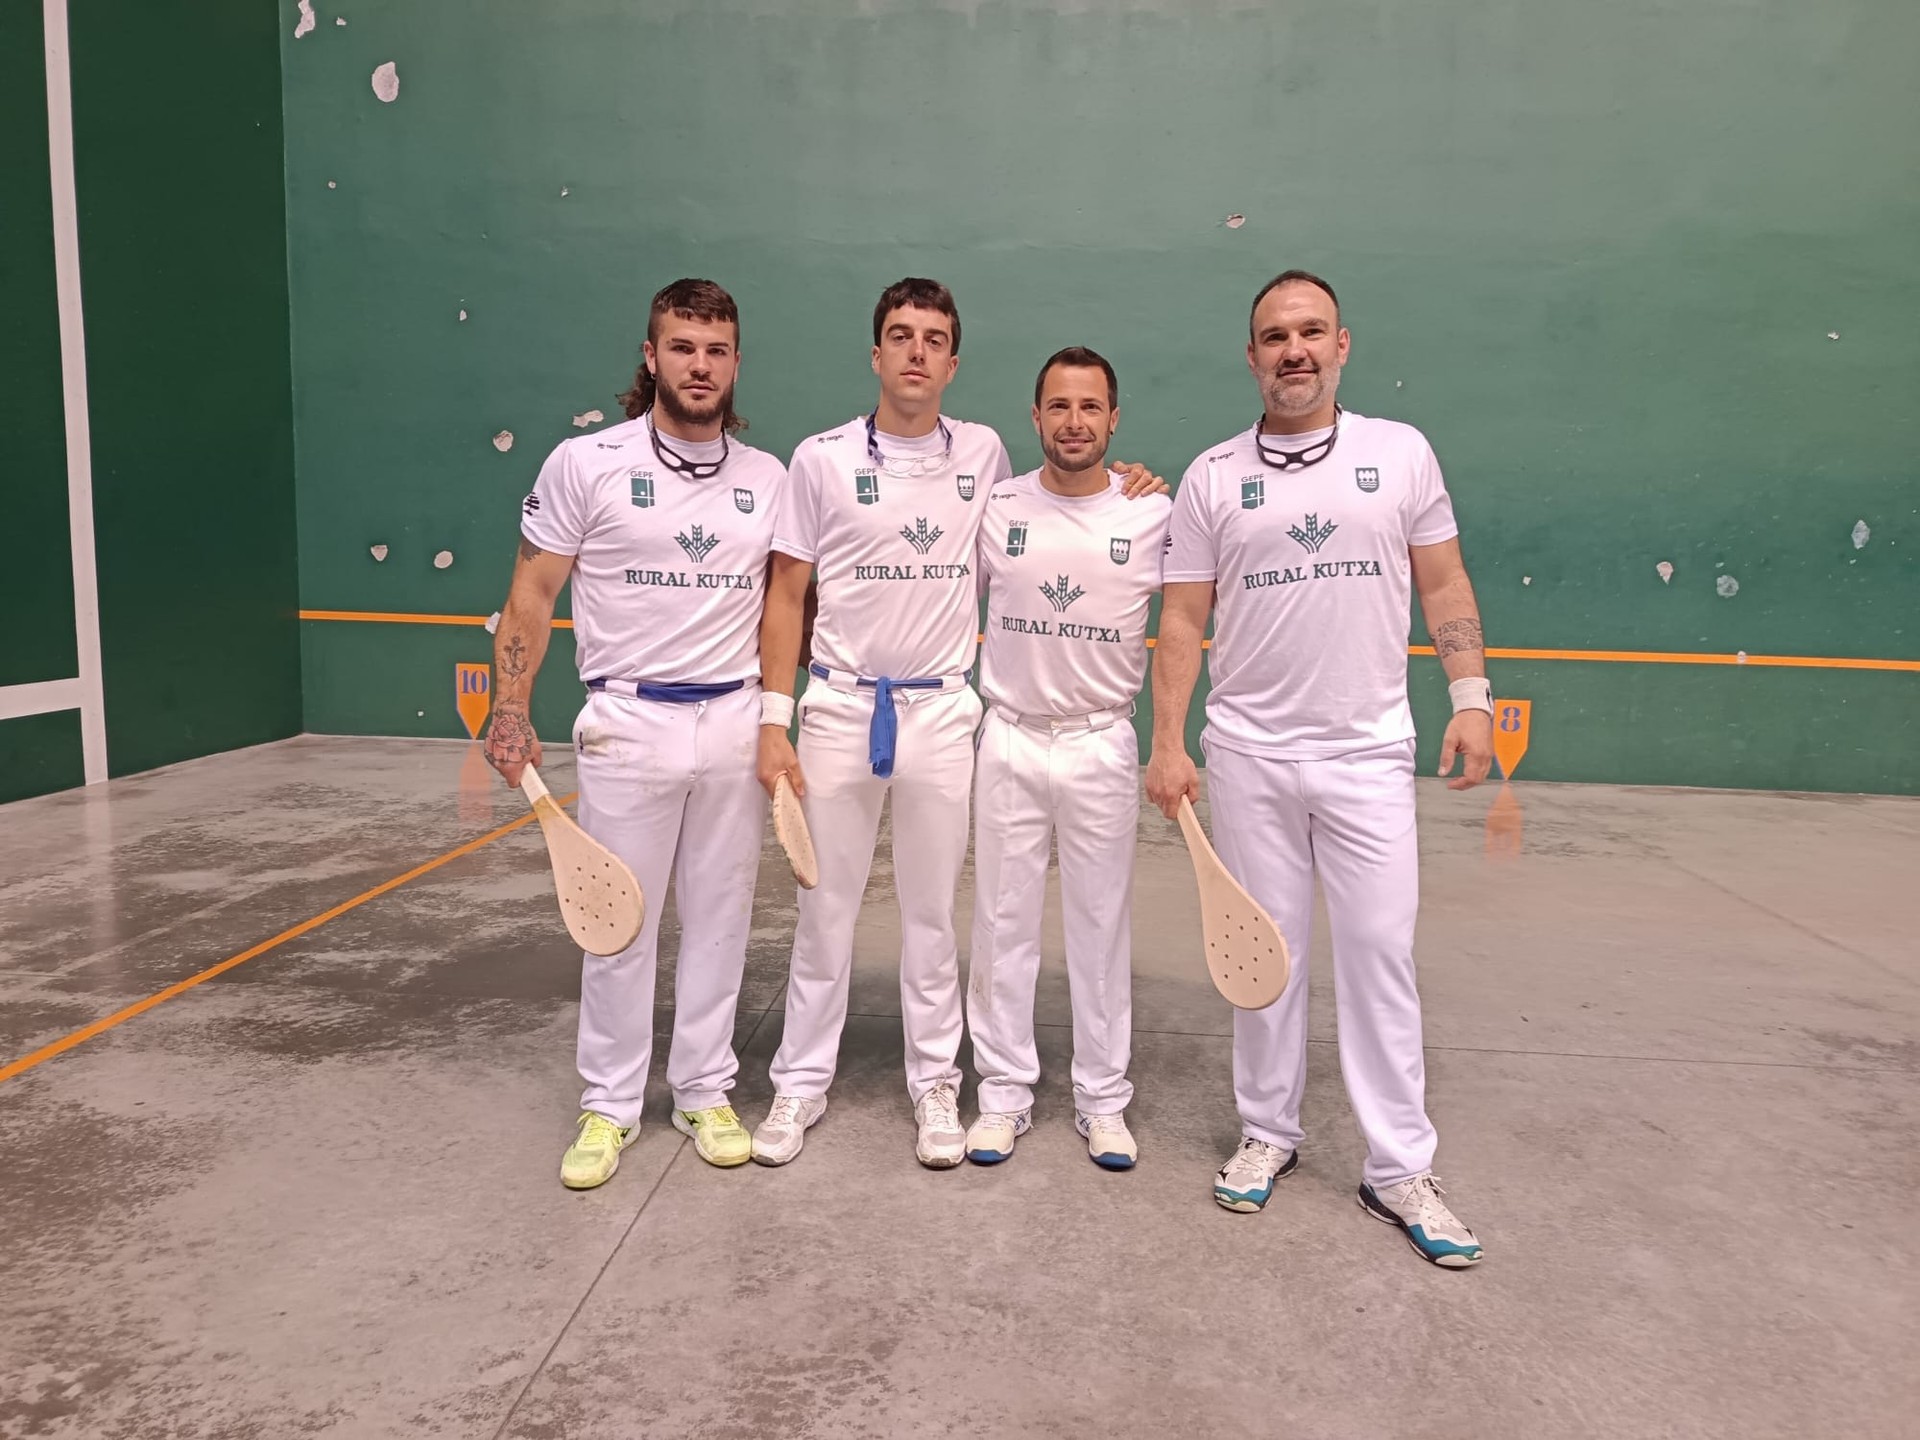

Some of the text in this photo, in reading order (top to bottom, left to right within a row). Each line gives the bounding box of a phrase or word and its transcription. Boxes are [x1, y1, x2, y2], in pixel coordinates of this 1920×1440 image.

[1241, 474, 1264, 483] GEPF
[1009, 520, 1030, 528] GEPF
[625, 569, 753, 590] RURAL KUTXA
[855, 564, 970, 580] RURAL KUTXA
[1243, 561, 1382, 590] RURAL KUTXA
[1002, 616, 1121, 643] RURAL KUTXA
[461, 670, 487, 694] 10
[1501, 706, 1521, 732] 8
